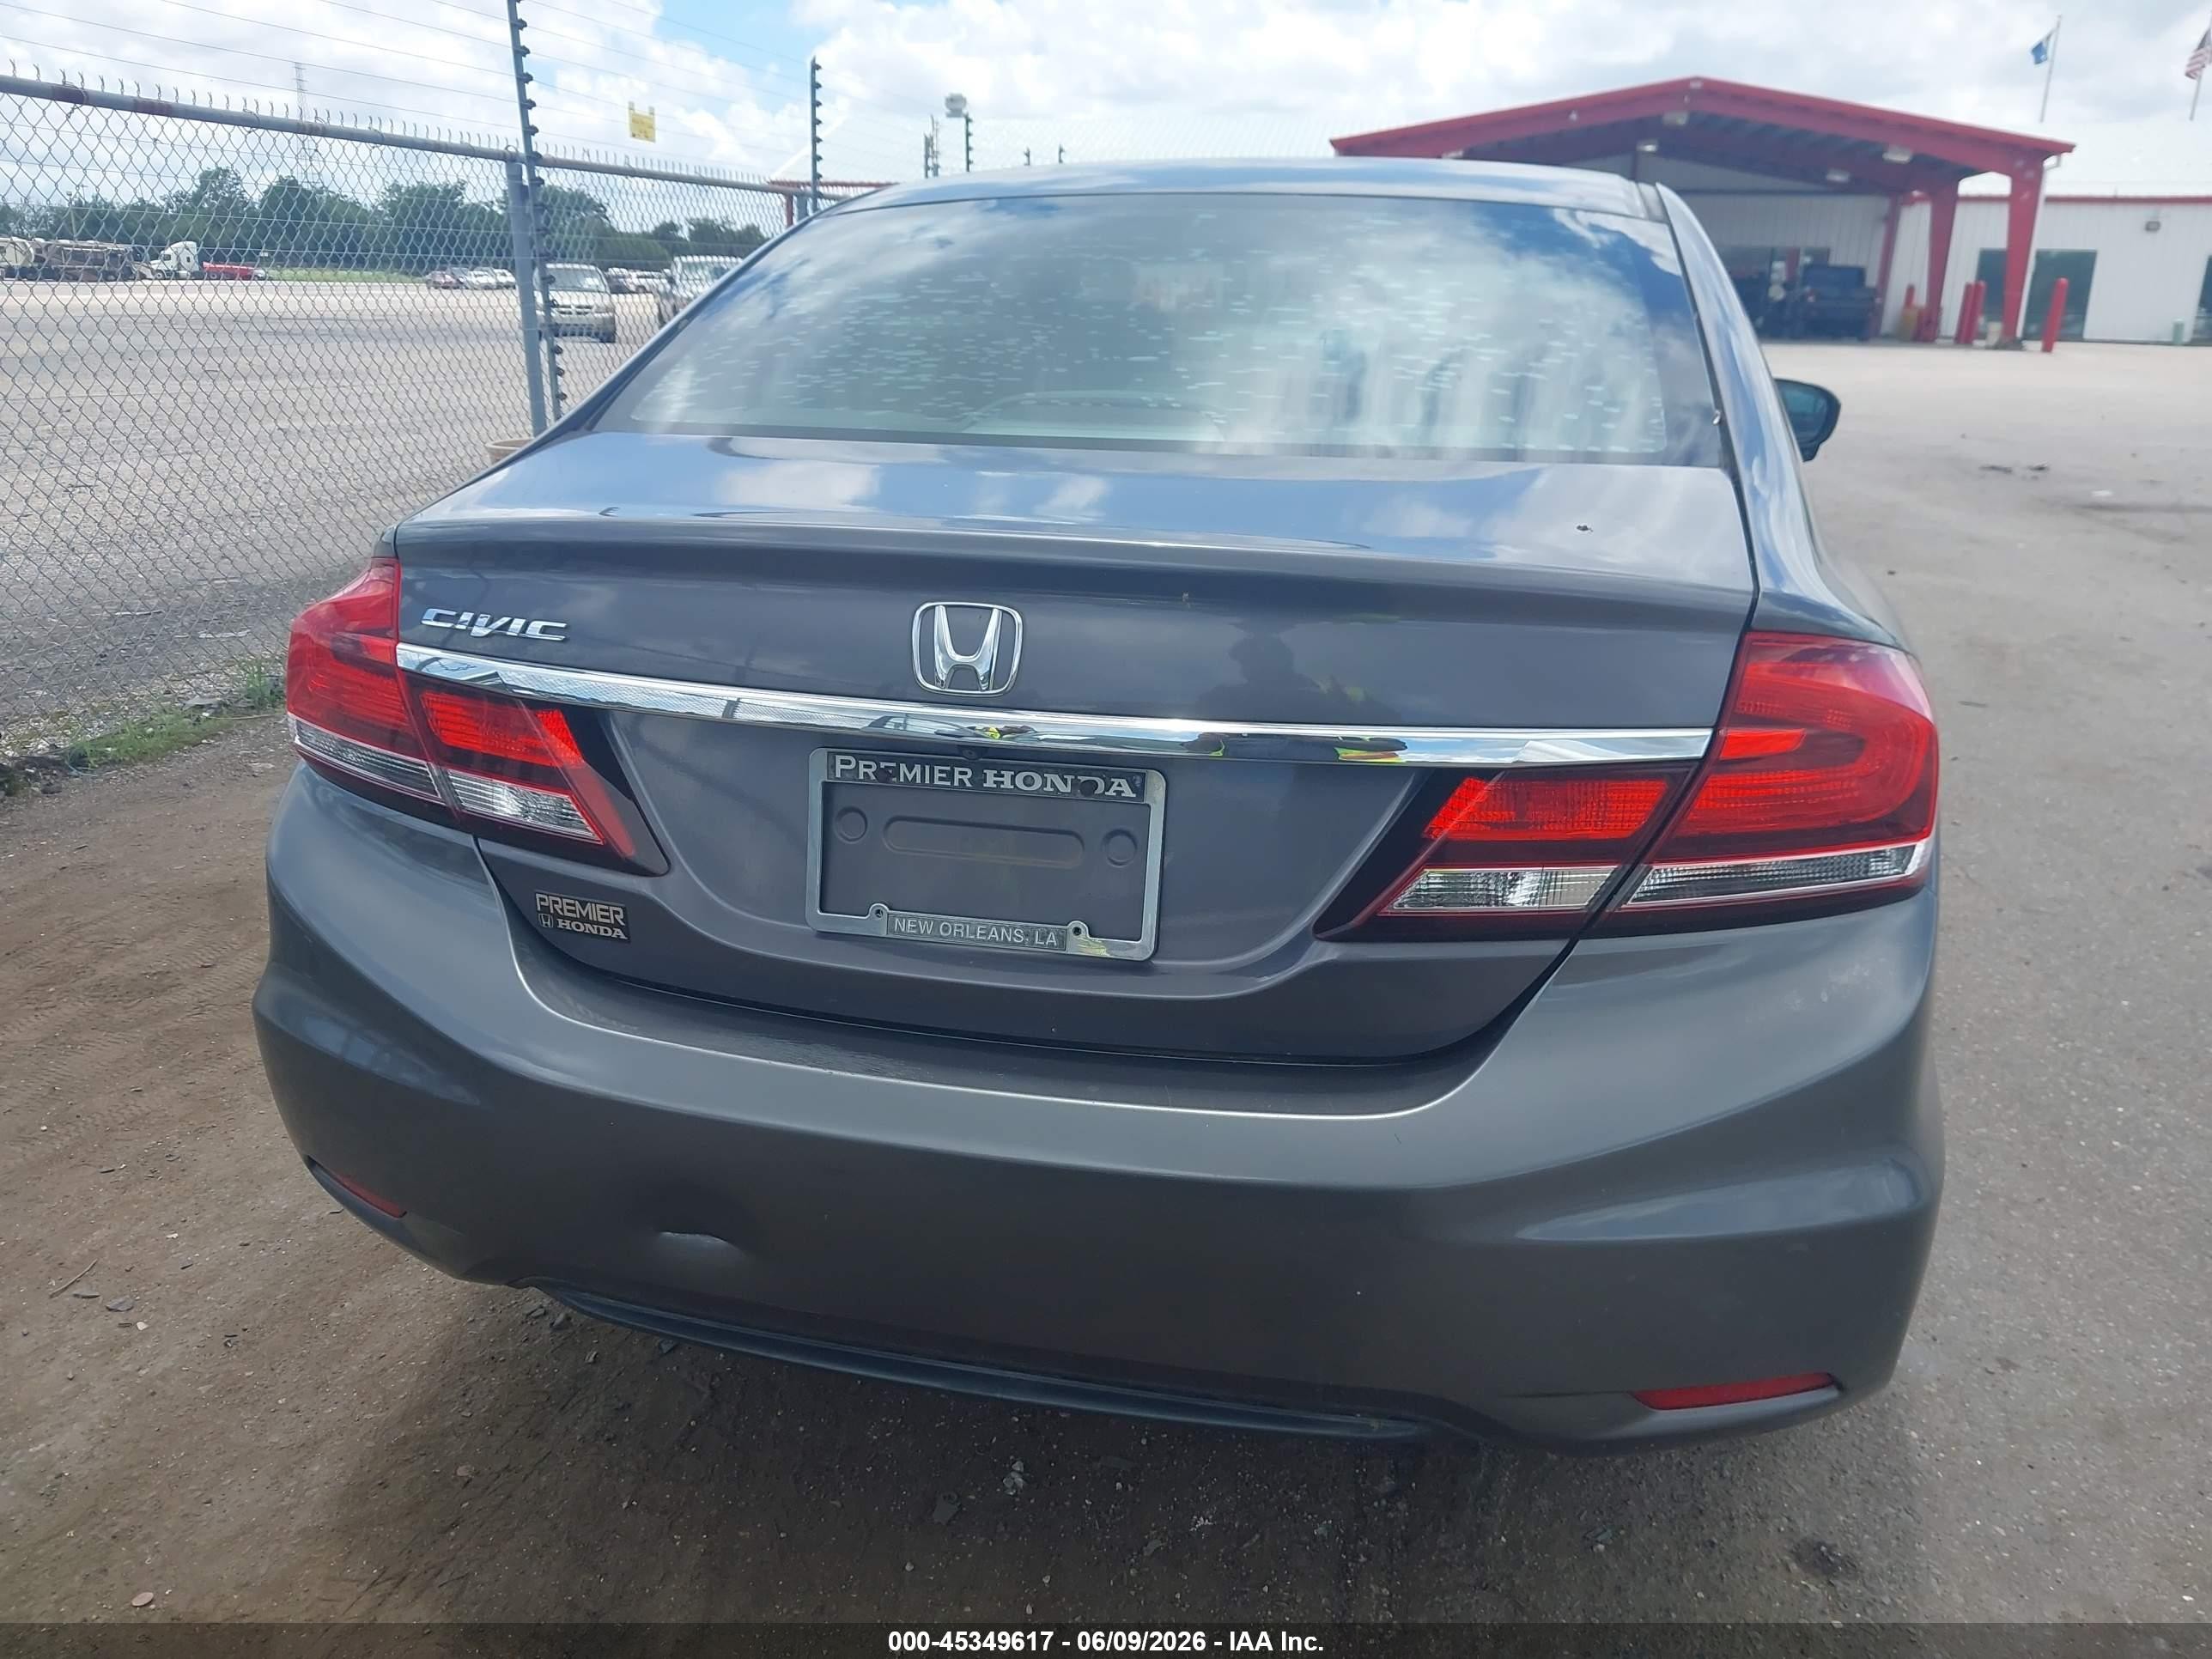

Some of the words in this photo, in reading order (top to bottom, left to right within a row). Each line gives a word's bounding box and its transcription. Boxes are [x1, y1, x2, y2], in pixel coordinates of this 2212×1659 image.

[421, 608, 568, 641] CIVIC
[535, 893, 626, 927] PREMIER
[556, 918, 628, 940] HONDA
[894, 918, 934, 935] NEW
[1035, 930, 1058, 946] LA
